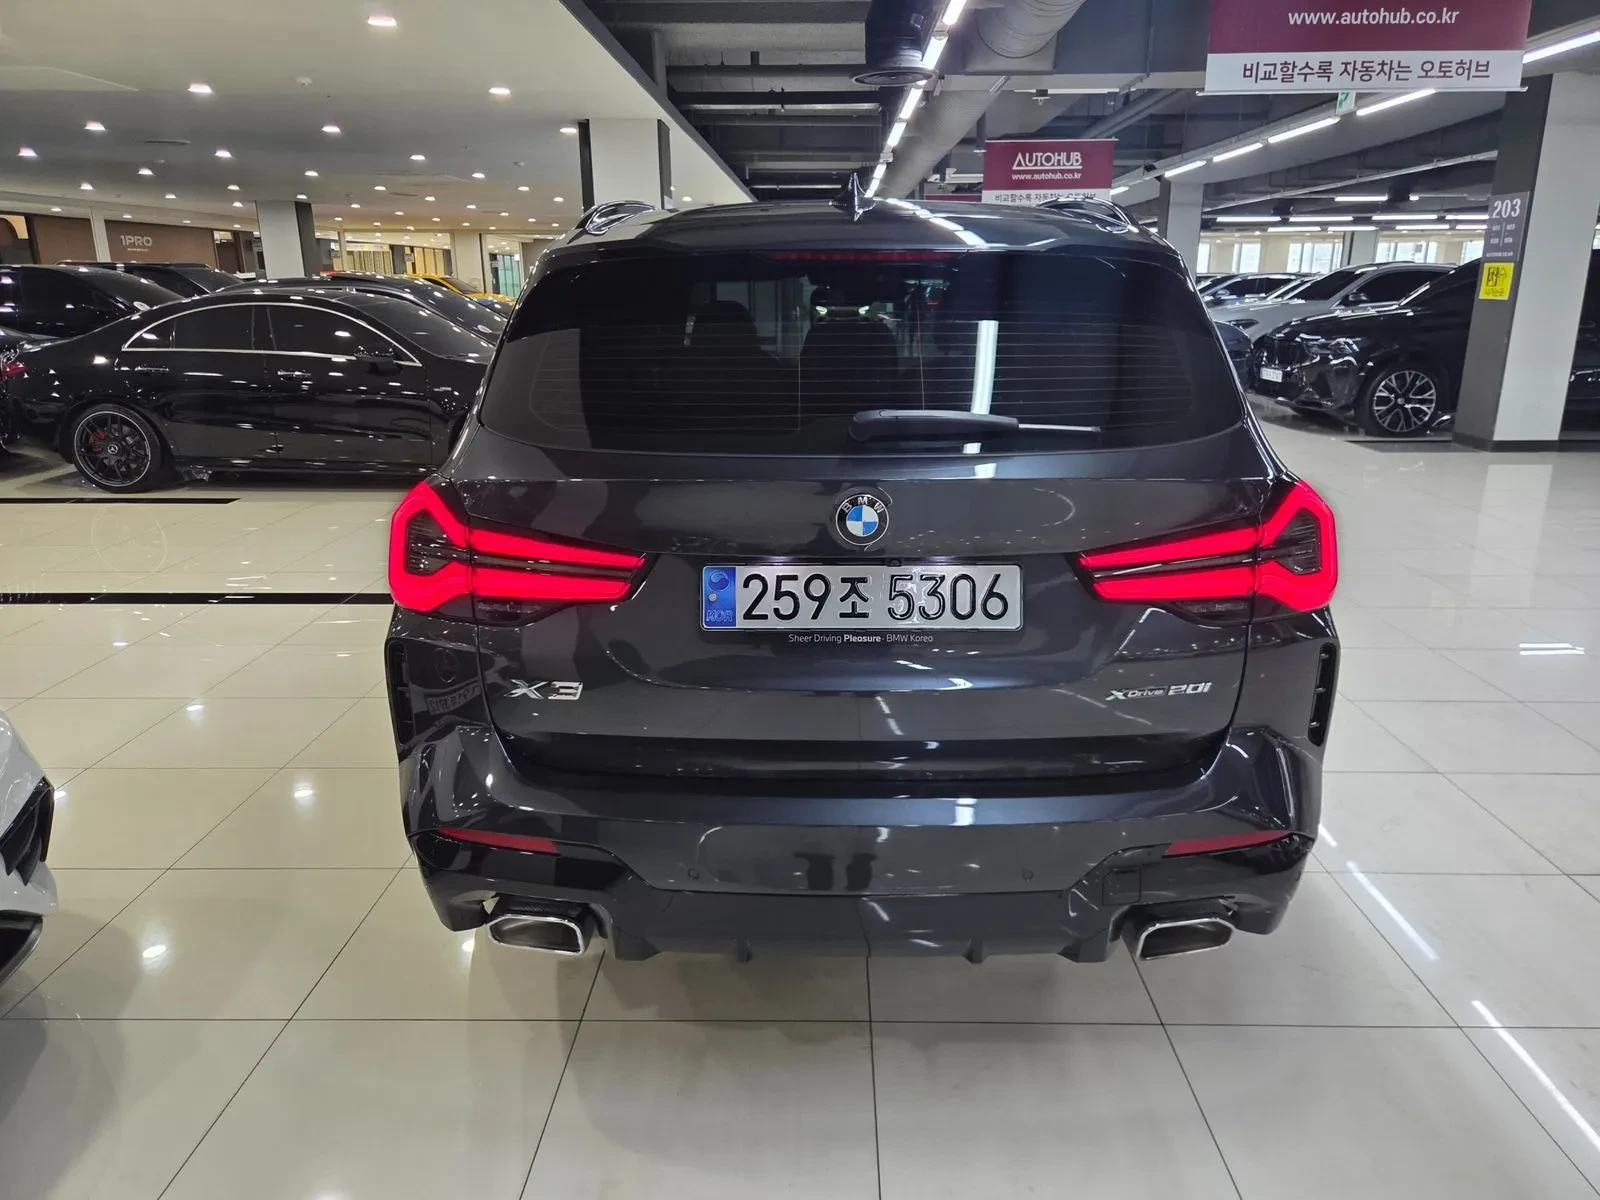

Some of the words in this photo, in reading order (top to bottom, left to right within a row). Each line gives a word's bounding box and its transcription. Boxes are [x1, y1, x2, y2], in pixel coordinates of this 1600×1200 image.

[1288, 8, 1459, 25] www.autohub.co.kr
[1243, 61, 1333, 83] 비교할수록
[1339, 61, 1412, 82] 자동차는
[1417, 60, 1490, 80] 오토허브
[1012, 152, 1082, 170] AUTOHUB
[1012, 172, 1082, 180] www.autohub.co.kr
[1492, 198, 1521, 219] 203
[120, 235, 153, 247] 1PRO
[842, 496, 884, 513] BMW
[742, 573, 870, 621] 259조
[887, 573, 1009, 621] 5306
[706, 609, 733, 622] KOR
[788, 634, 812, 643] Sheer
[813, 634, 842, 643] Driving
[886, 634, 908, 643] BMW
[910, 634, 933, 643] Korea
[504, 680, 583, 700] X3
